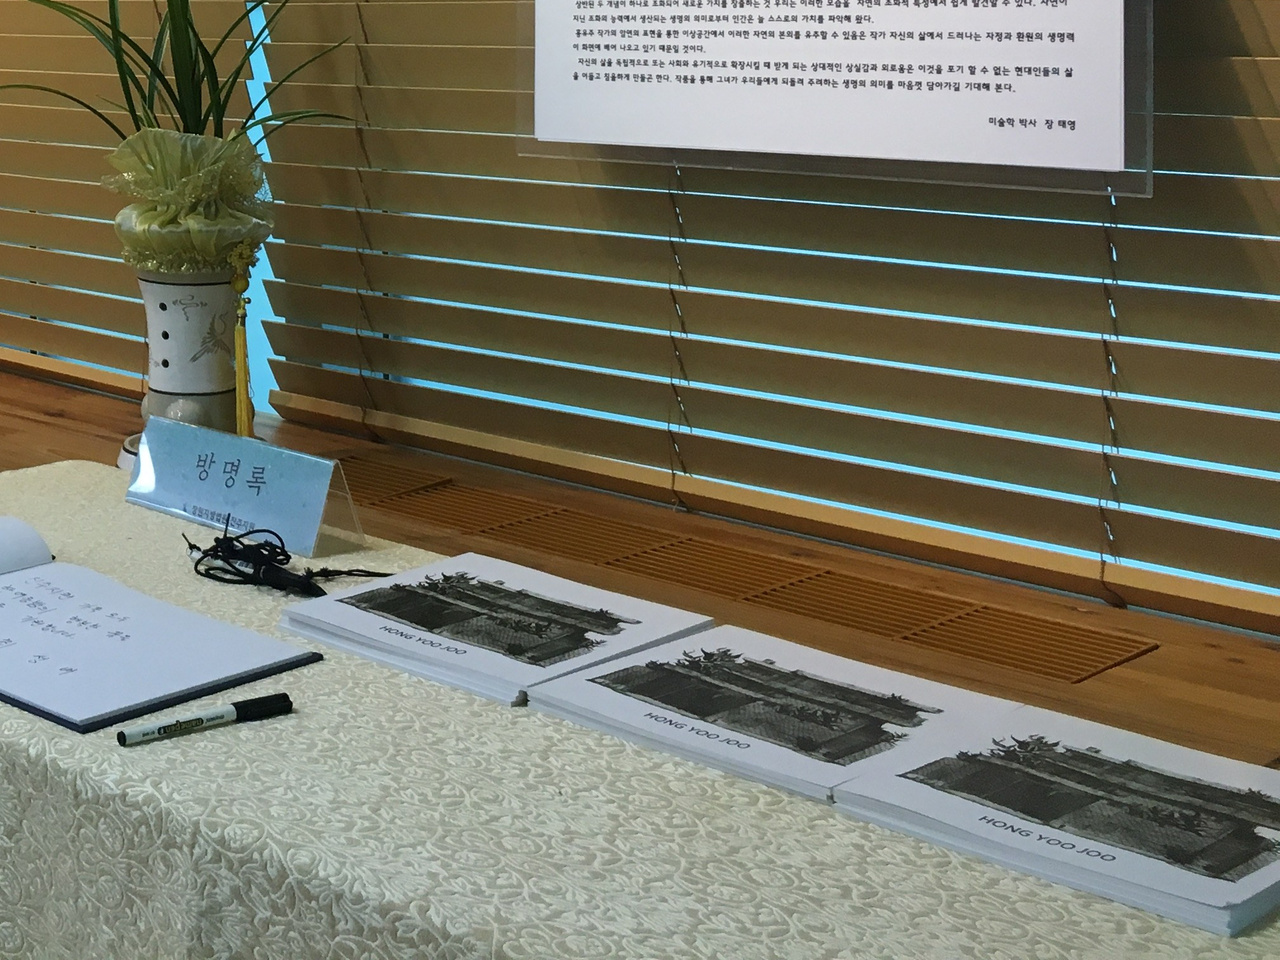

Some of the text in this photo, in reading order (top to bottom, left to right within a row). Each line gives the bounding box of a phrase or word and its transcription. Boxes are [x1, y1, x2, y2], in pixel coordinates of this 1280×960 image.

[917, 31, 1075, 43] 삶에서 드러나는 자정과 환원의 생명력
[917, 64, 1074, 78] 이것을 포기 할 수 없는 현대인들의 삶
[926, 81, 961, 92] 담아가길
[964, 81, 991, 92] 기대해
[994, 82, 1016, 94] 본다.
[988, 116, 1076, 131] 미술학 박사 장 태영
[195, 451, 267, 497] 방명록
[379, 625, 468, 655] HONG YOO JOO
[643, 712, 752, 750] HONG YOO JOO
[978, 815, 1117, 863] HONG YOO JOO
